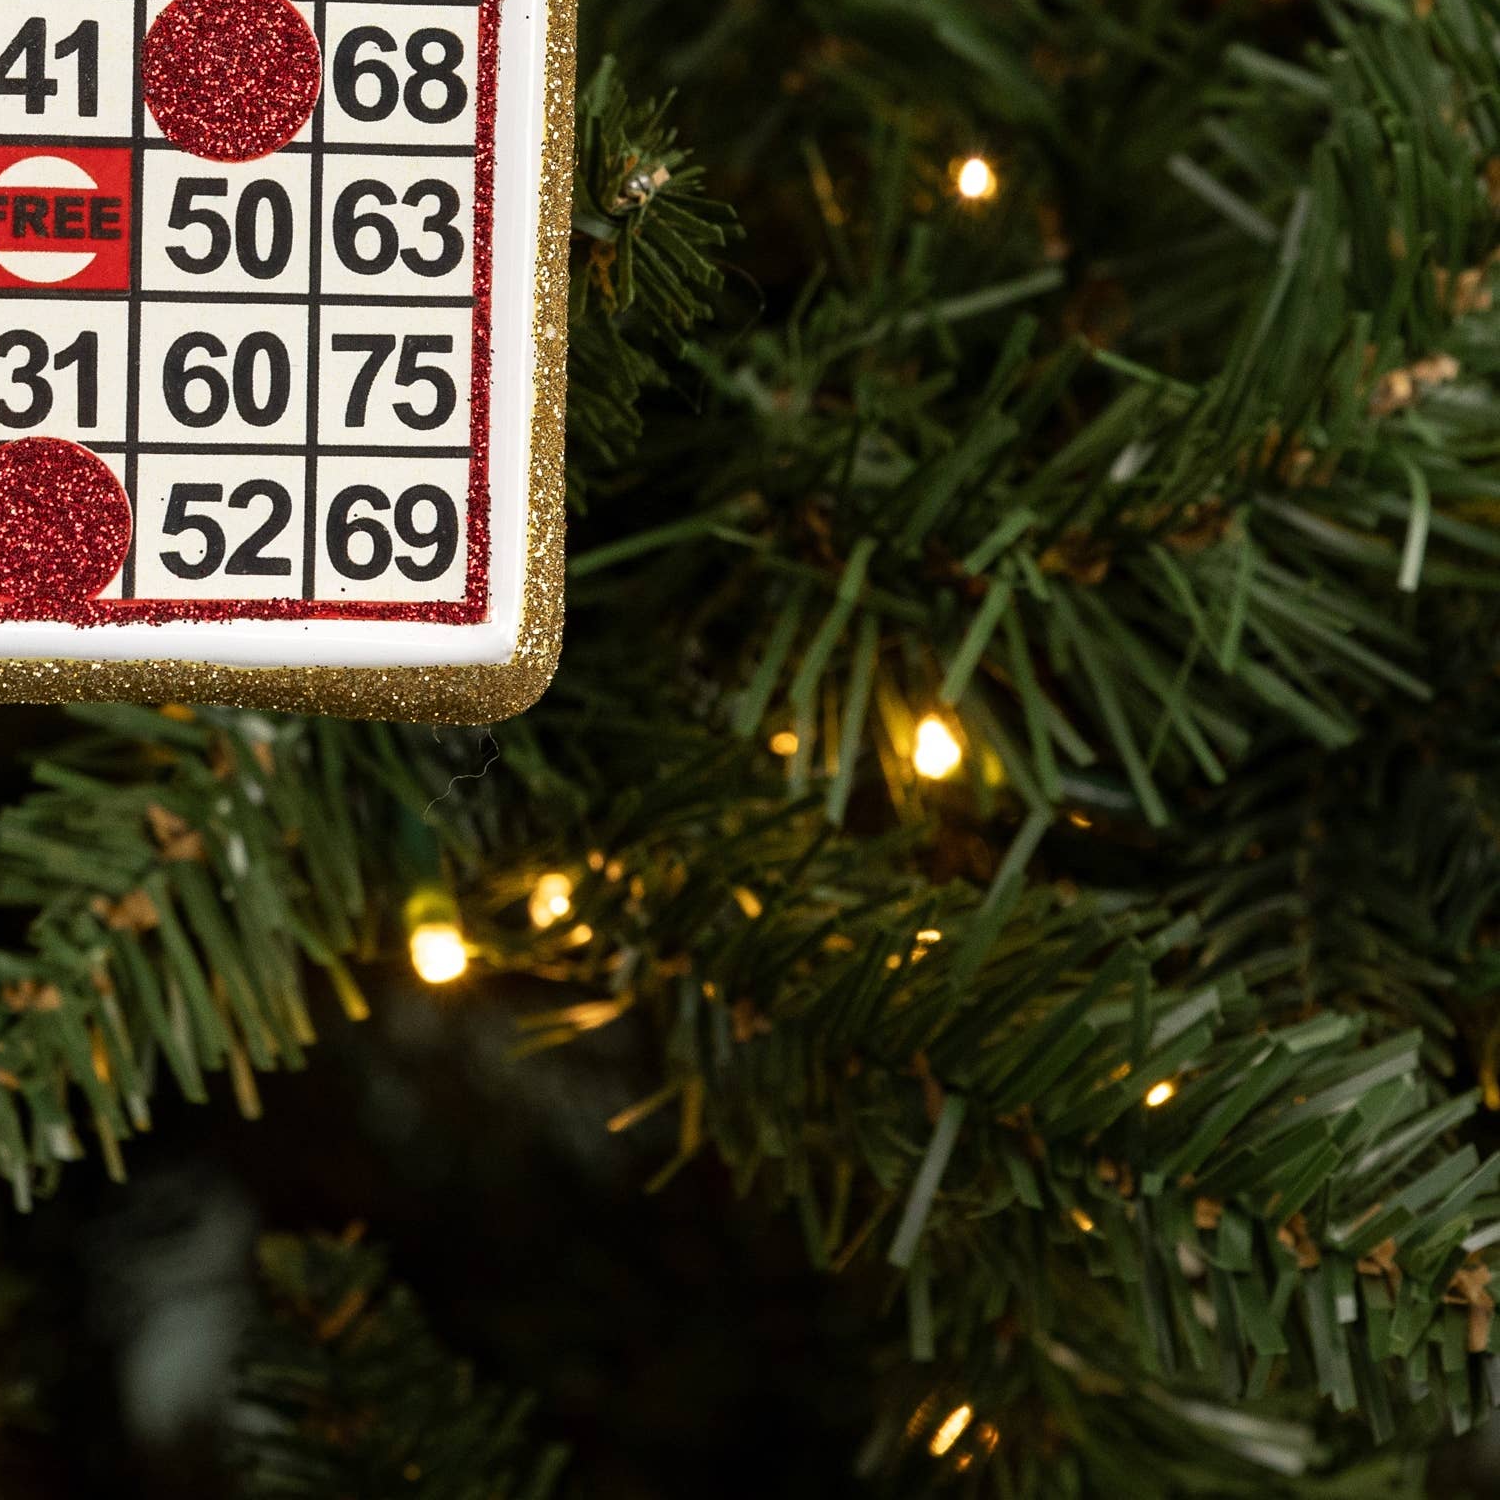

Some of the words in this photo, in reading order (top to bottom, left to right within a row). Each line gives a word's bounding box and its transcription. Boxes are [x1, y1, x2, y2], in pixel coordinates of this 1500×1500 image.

[333, 26, 467, 123] 68
[166, 178, 293, 279] 50
[333, 179, 464, 277] 63
[163, 332, 290, 427] 60
[332, 334, 456, 430] 75
[160, 480, 292, 579] 52
[326, 484, 458, 581] 69
